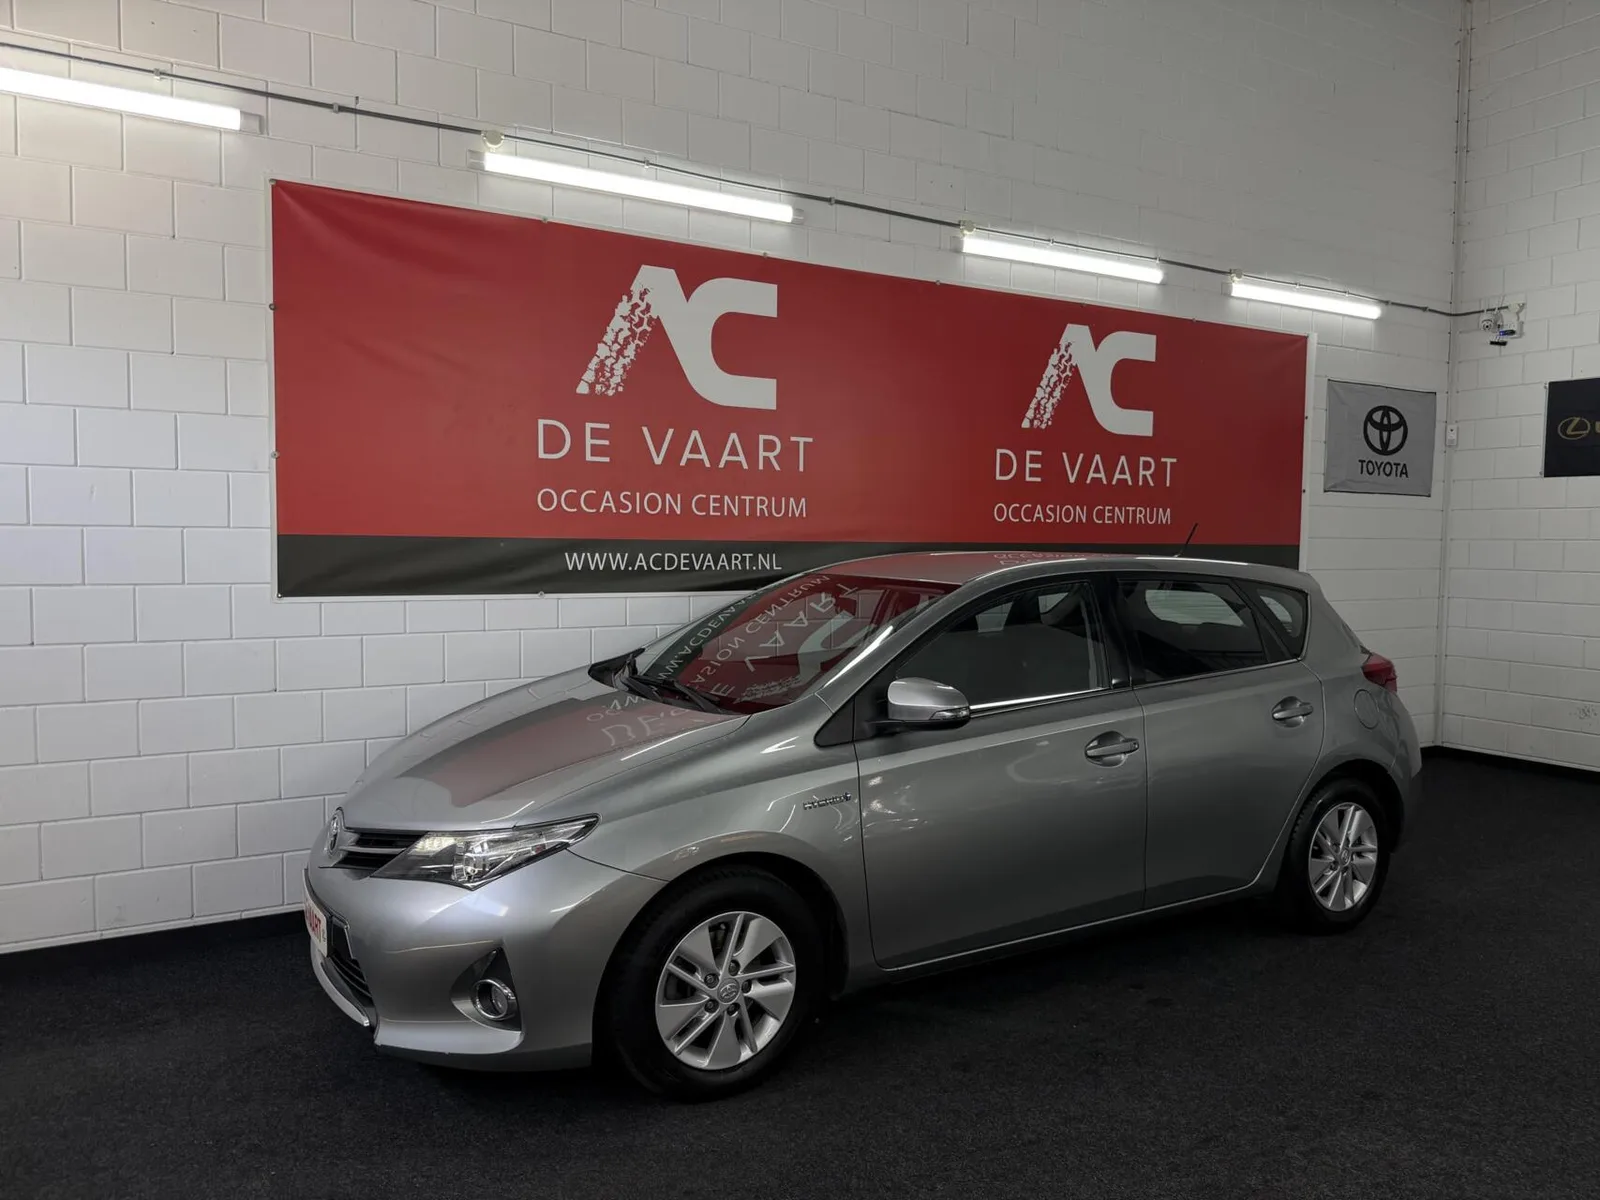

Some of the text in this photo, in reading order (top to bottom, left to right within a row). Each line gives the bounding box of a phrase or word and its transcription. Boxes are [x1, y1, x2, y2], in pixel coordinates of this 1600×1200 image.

[575, 264, 778, 411] AC
[1021, 323, 1157, 437] AC
[537, 418, 814, 472] DE VAART
[995, 448, 1178, 487] DE VAART
[1358, 459, 1409, 478] TOYOTA
[537, 488, 807, 518] OCCASION CENTRUM
[993, 503, 1172, 525] OCCASION CENTRUM
[564, 552, 782, 571] WWW.ACDEVAART.NL
